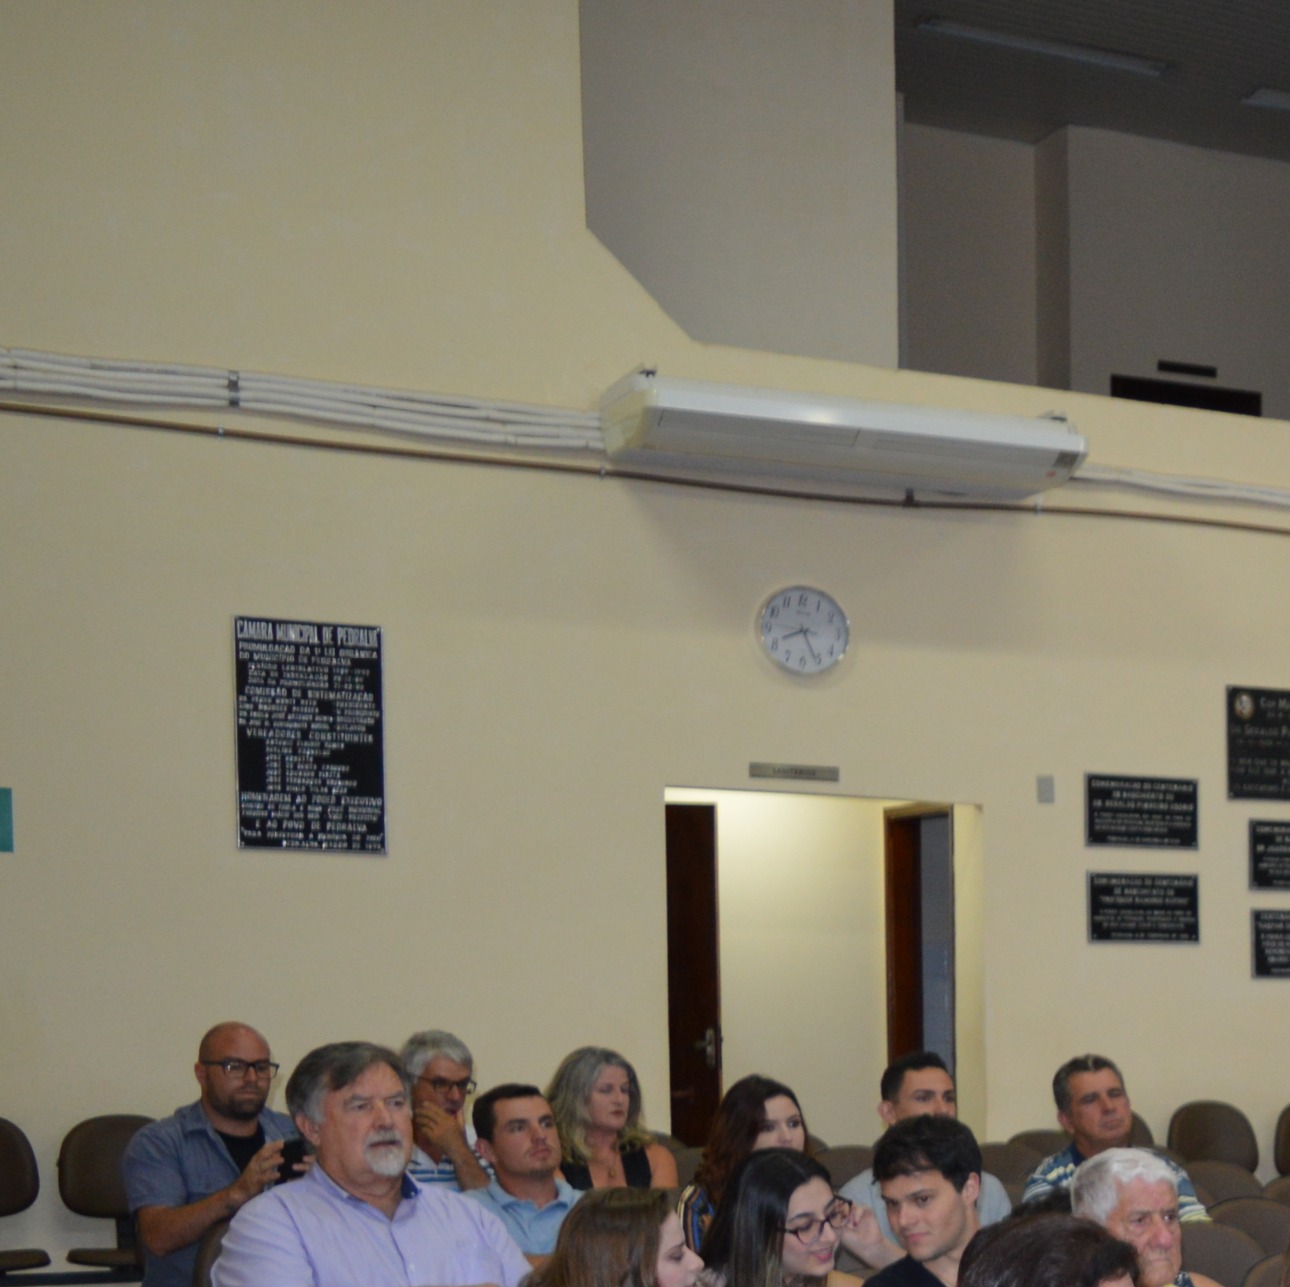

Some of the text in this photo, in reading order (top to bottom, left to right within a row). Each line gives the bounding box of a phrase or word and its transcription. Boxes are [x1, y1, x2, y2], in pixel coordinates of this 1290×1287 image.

[276, 623, 320, 644] MUNICIPAL
[323, 626, 333, 644] DE
[326, 822, 367, 831] PEDRALVA
